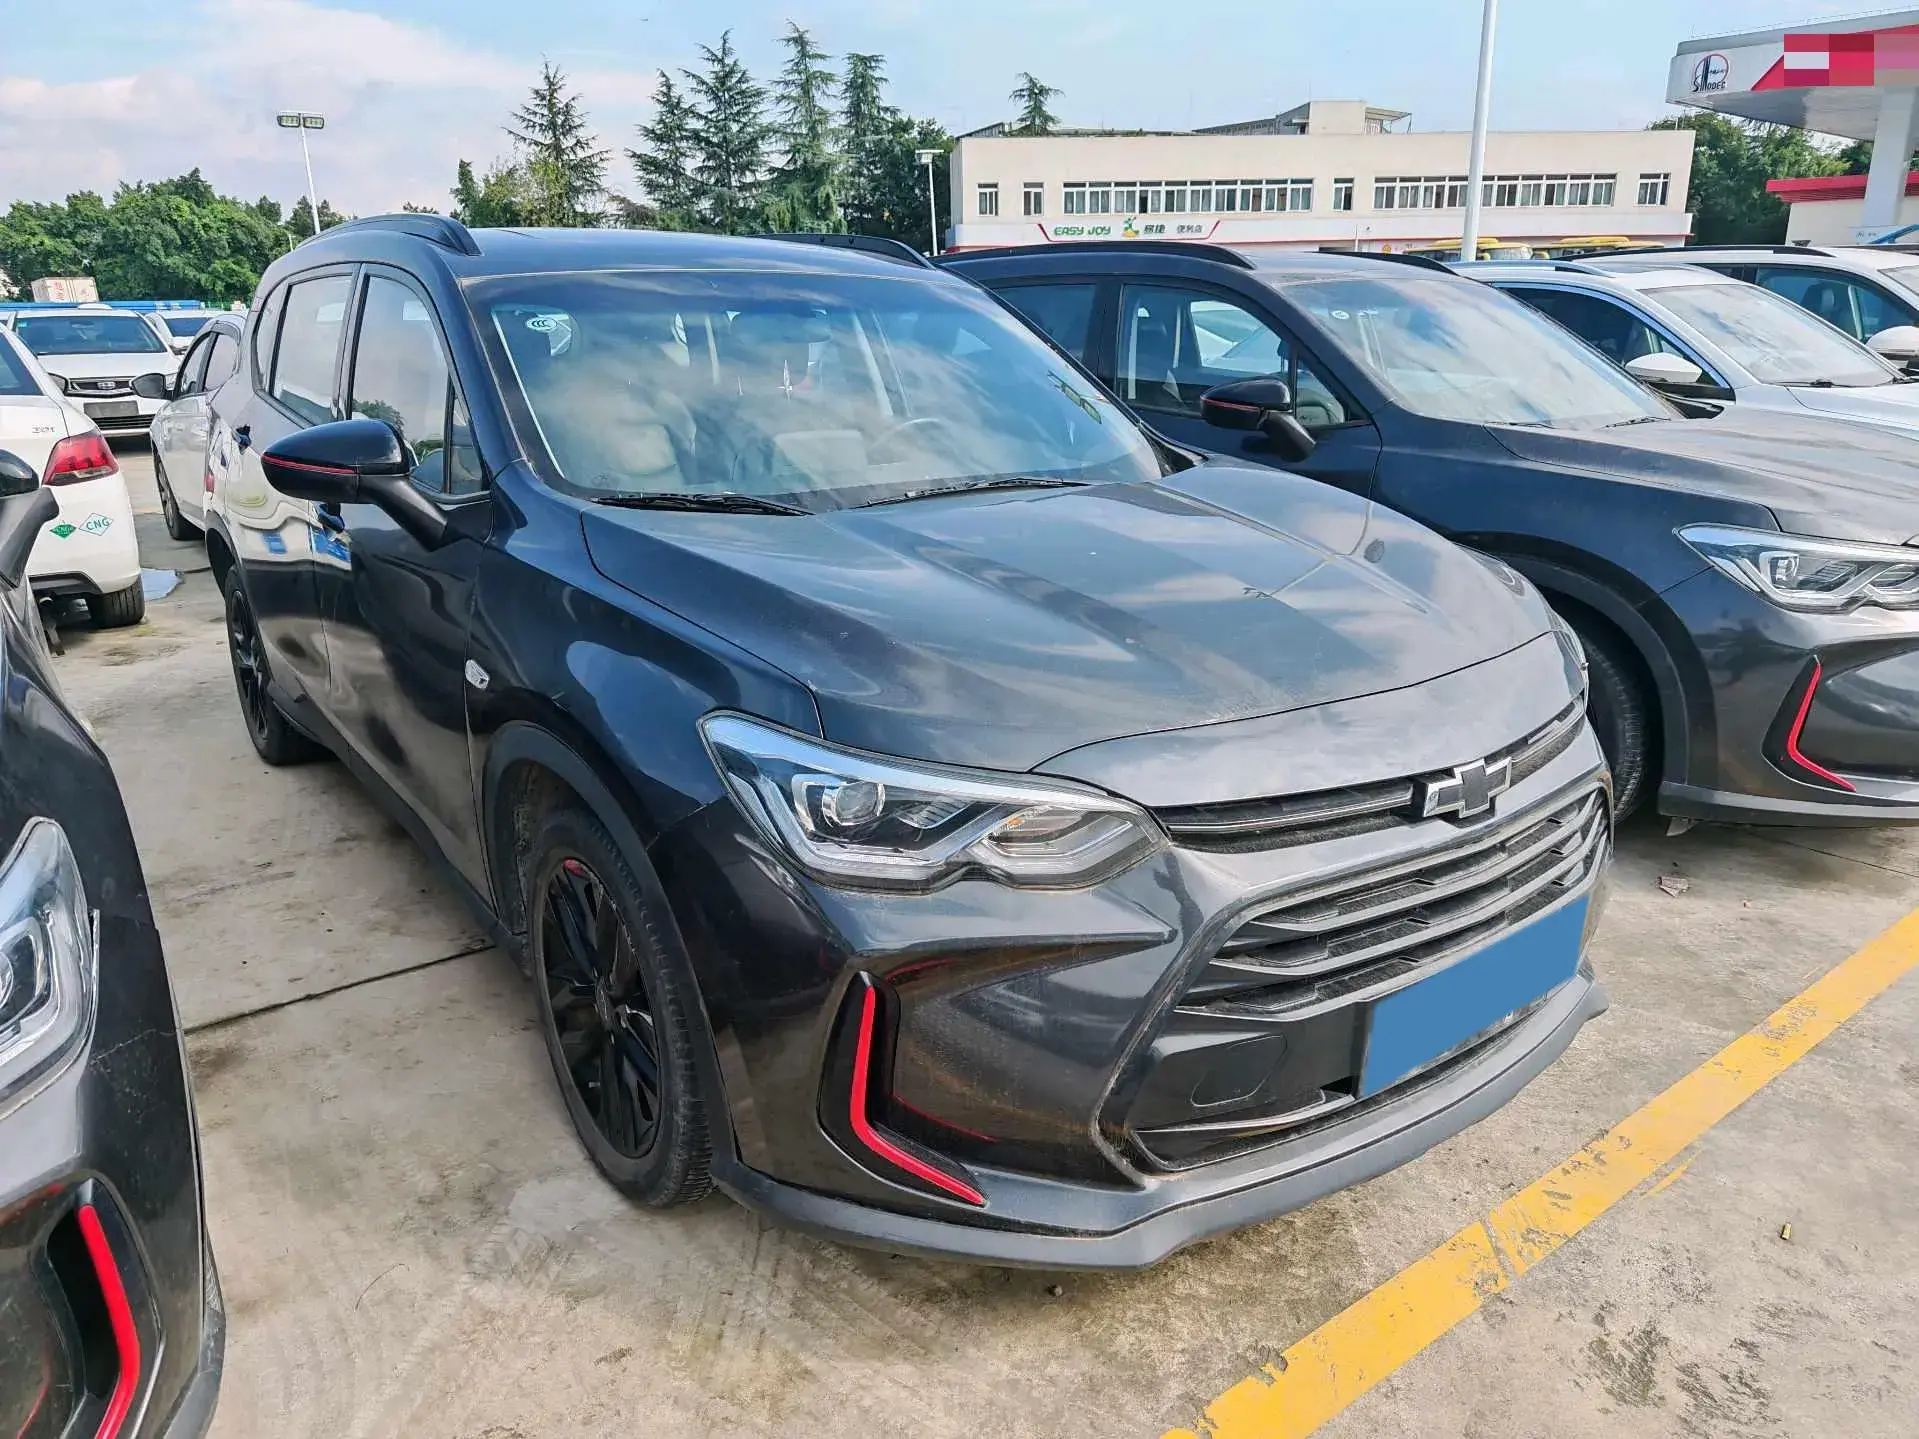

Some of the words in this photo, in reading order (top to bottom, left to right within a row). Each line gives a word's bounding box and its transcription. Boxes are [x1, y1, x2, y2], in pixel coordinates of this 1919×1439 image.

[1054, 226, 1084, 236] EASY
[1087, 226, 1111, 236] JOY
[86, 517, 110, 531] CNG
